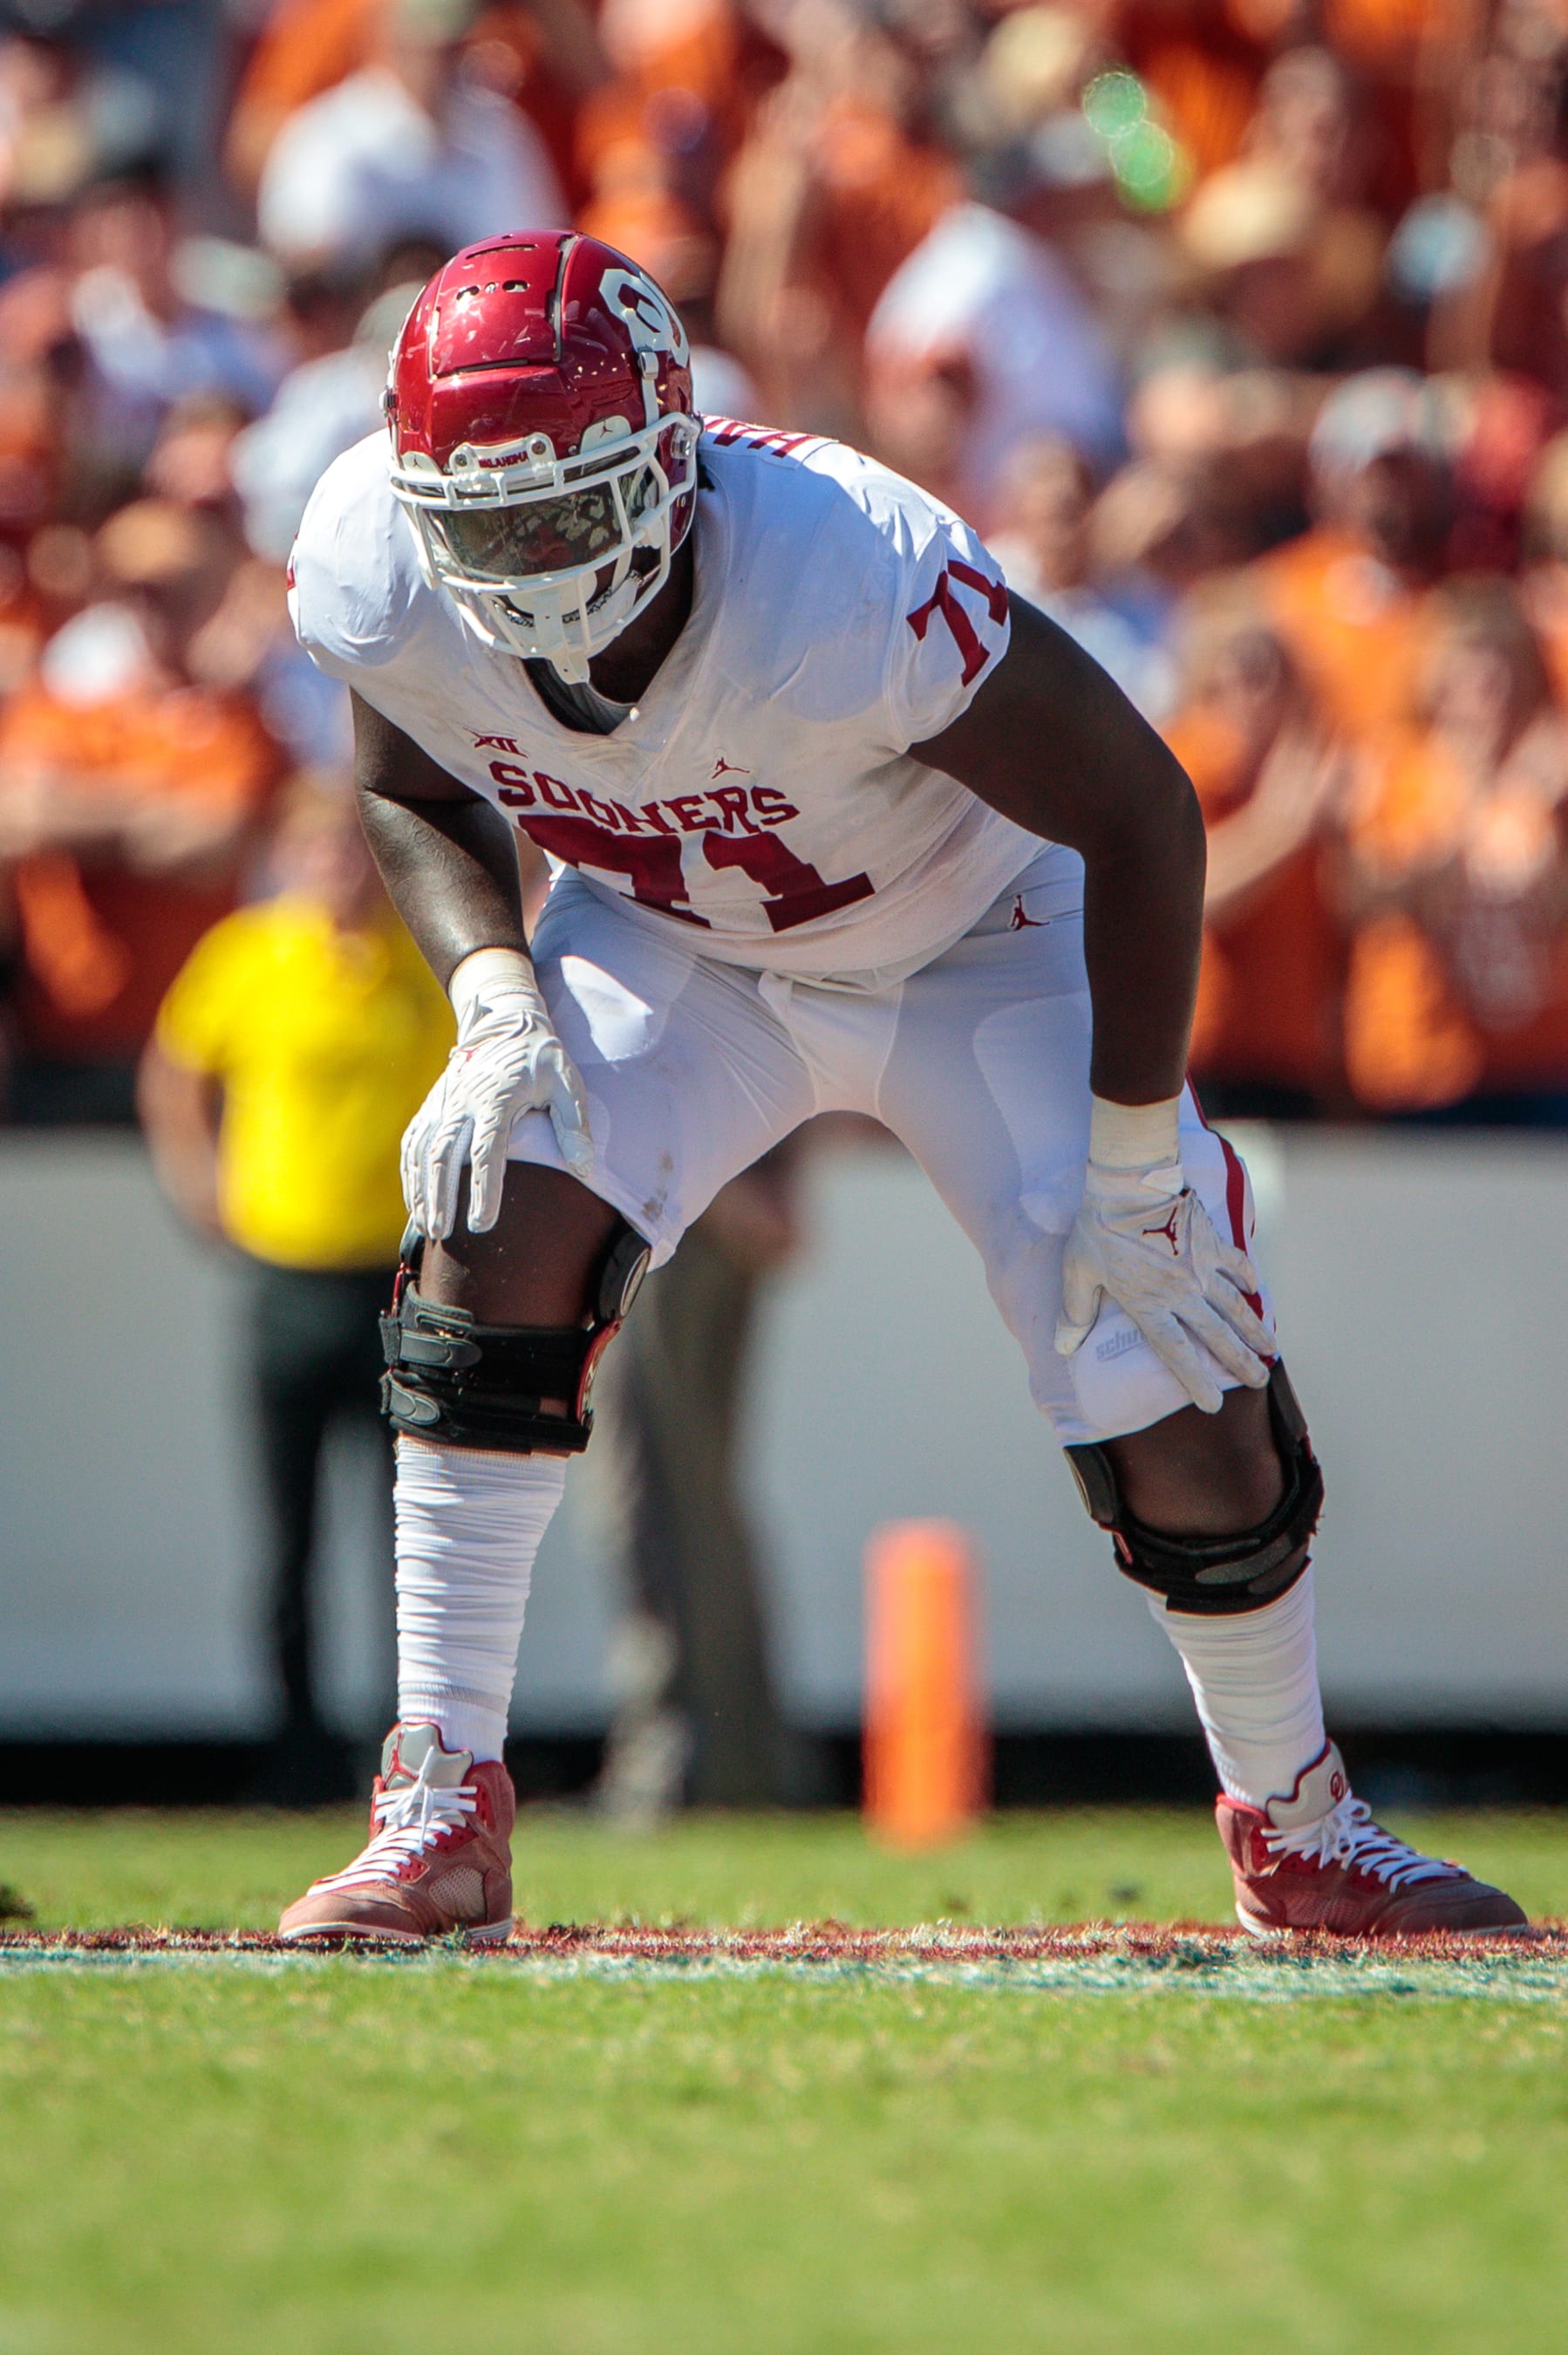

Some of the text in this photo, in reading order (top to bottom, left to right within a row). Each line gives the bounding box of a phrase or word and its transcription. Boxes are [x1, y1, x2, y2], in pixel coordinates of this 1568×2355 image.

[906, 559, 1009, 687] 71
[487, 761, 801, 835] SOONERS
[518, 814, 876, 932] 71
